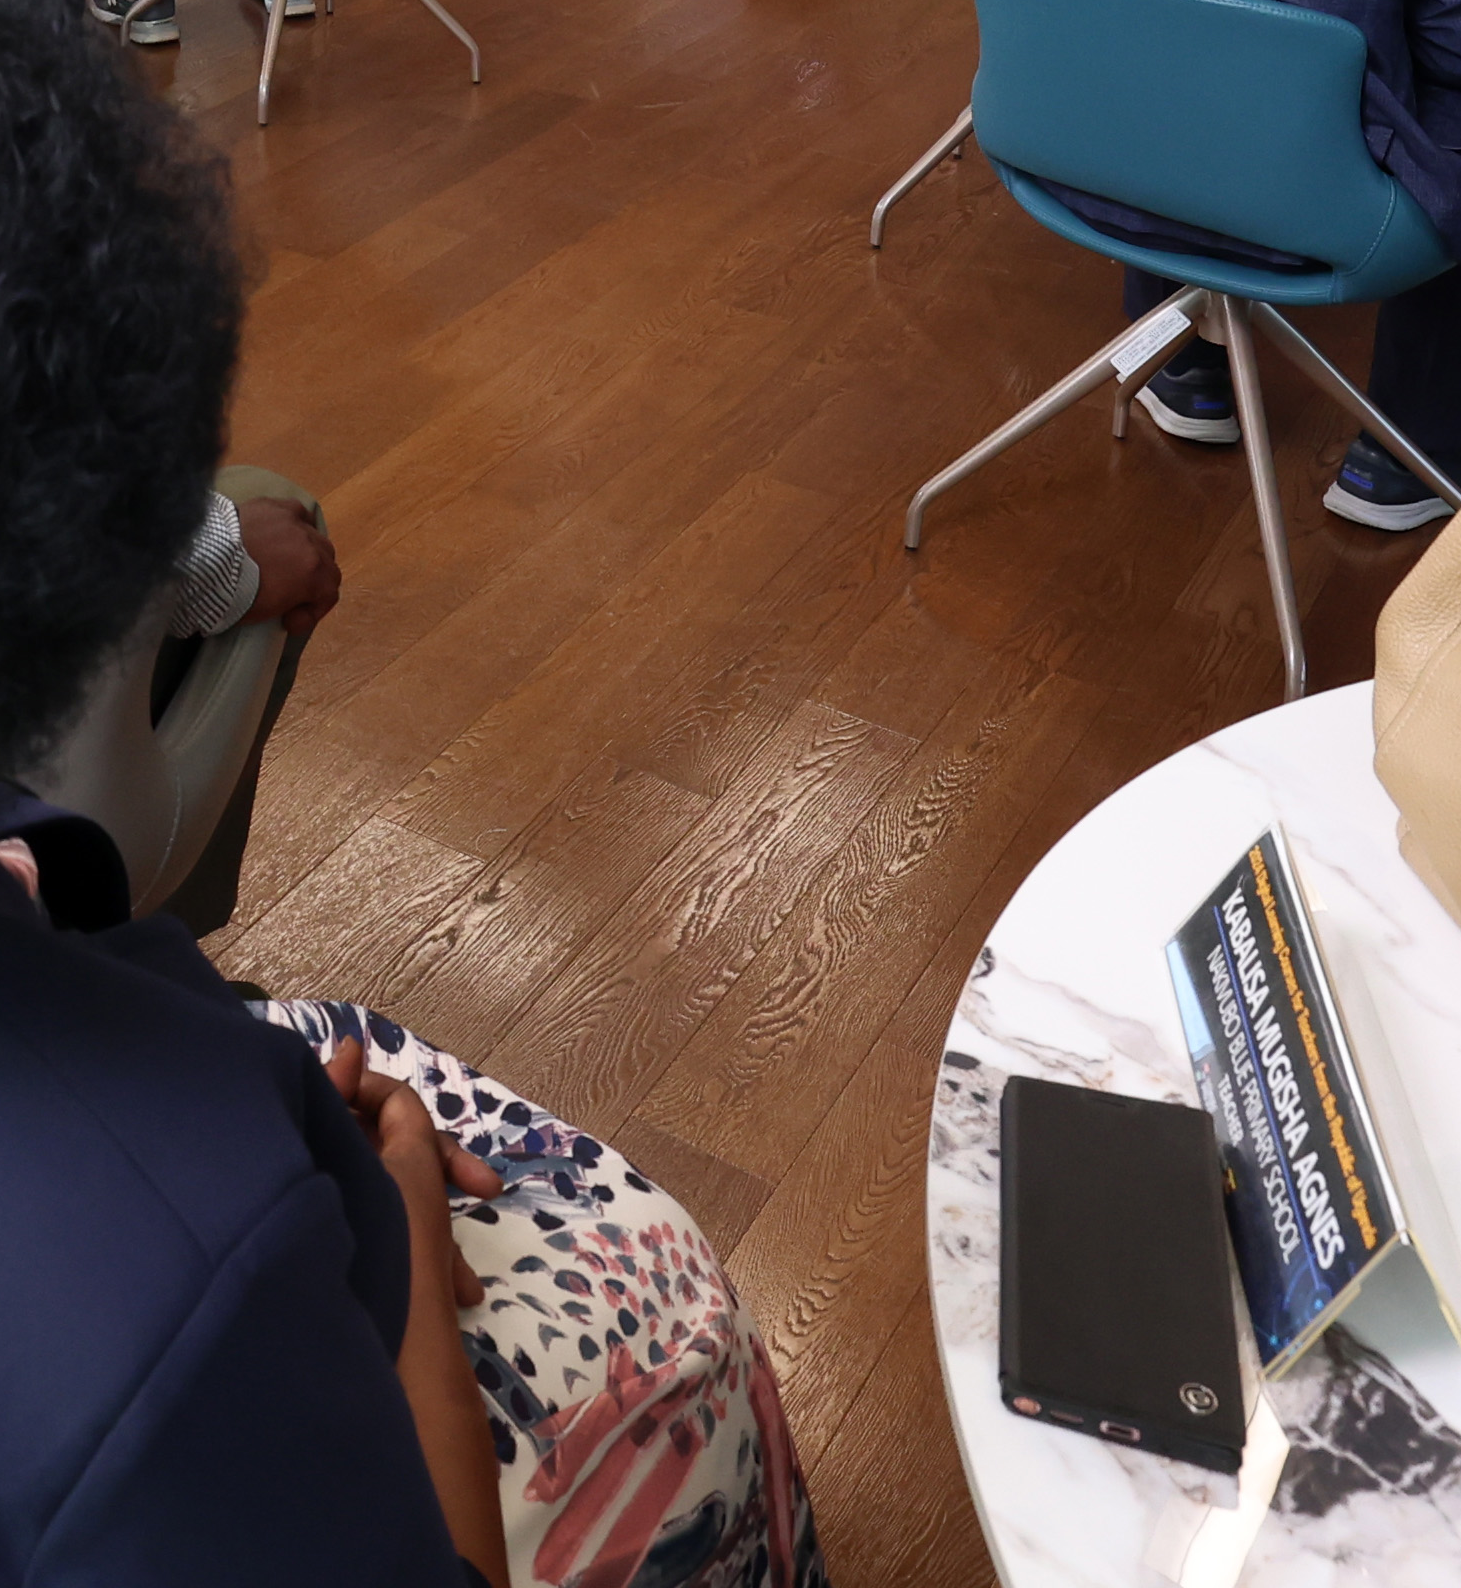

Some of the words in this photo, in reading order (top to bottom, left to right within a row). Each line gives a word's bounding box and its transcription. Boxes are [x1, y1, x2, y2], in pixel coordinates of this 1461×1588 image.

[1220, 884, 1271, 1018] KABALISA
[1253, 1003, 1312, 1159] MUGISHA
[1291, 1143, 1346, 1275] AGNES
[1227, 1028, 1255, 1089] BLUE
[1217, 1071, 1244, 1148] TEACHER
[1239, 1074, 1277, 1173] PRIMARY
[1262, 1162, 1303, 1267] SCHOOL
